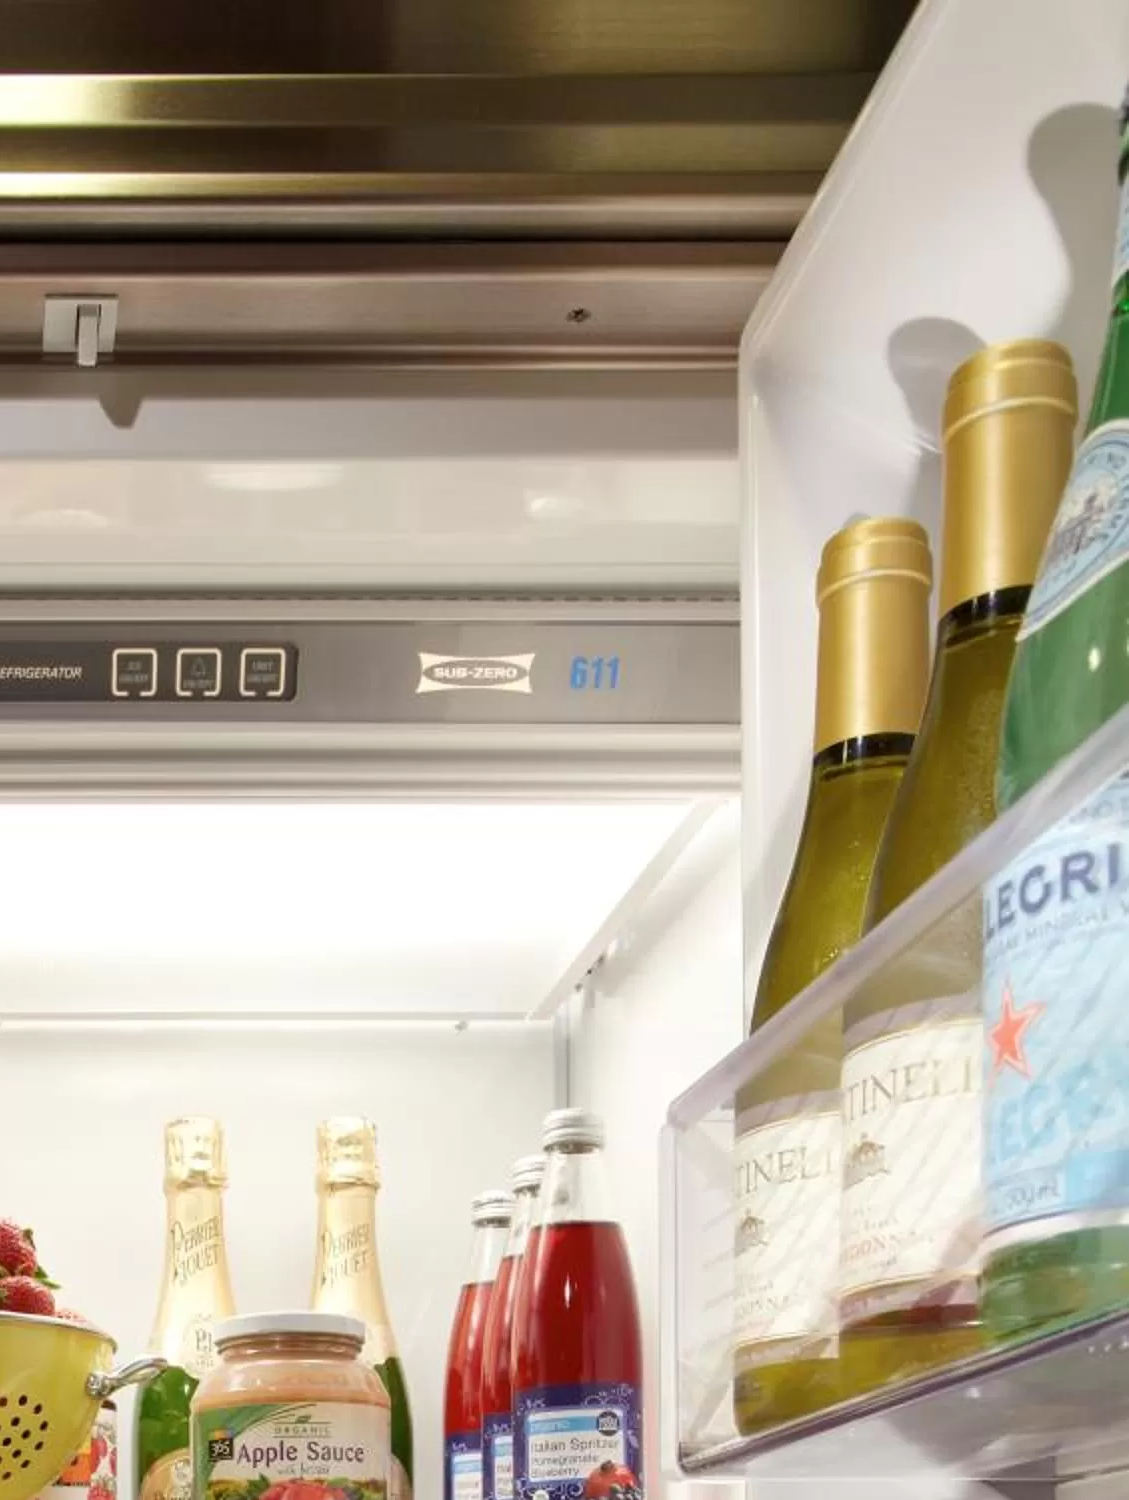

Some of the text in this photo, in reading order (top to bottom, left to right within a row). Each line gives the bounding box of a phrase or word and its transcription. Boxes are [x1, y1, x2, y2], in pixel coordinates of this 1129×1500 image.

[433, 666, 518, 680] SUB-ZERO
[569, 656, 620, 689] 611
[273, 1425, 332, 1436] ORGANIC
[236, 1441, 365, 1468] Apple Sauce
